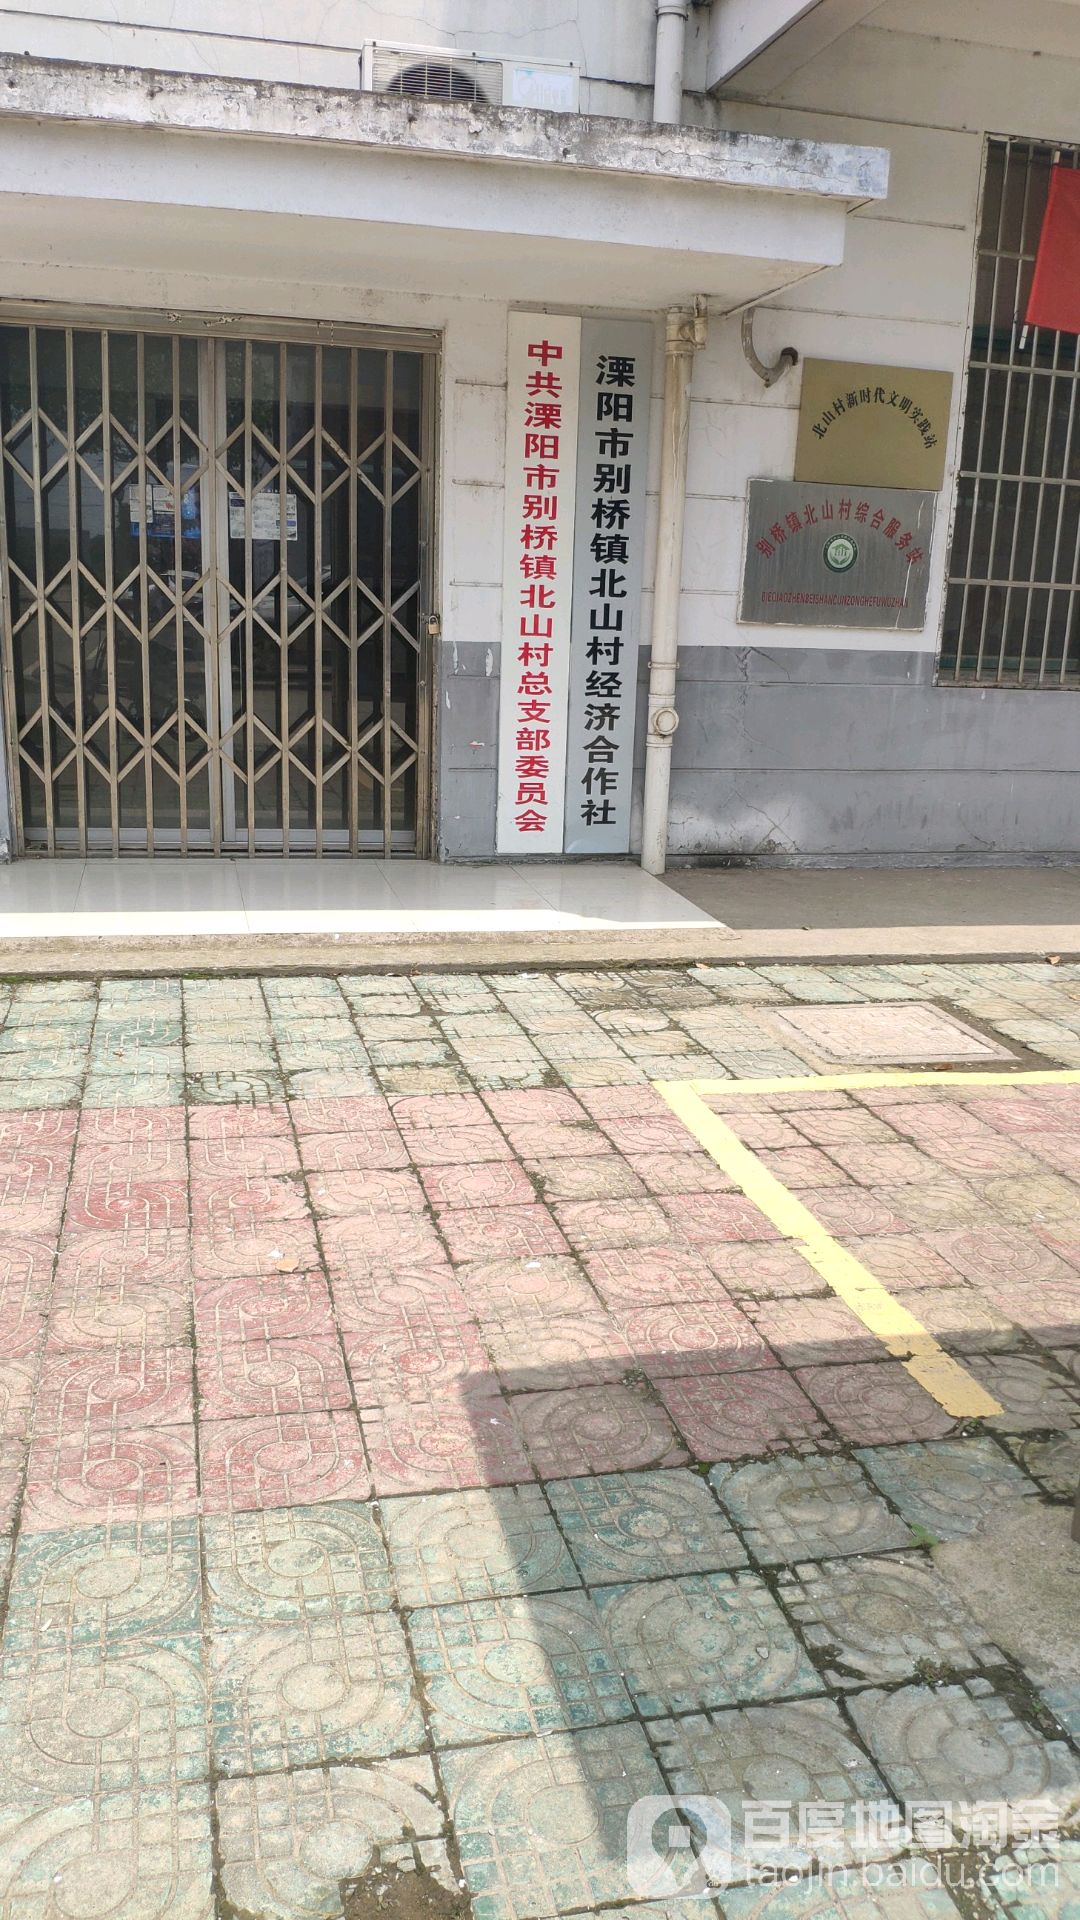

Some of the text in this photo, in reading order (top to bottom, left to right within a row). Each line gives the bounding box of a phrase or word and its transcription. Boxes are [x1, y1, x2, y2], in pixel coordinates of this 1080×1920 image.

[755, 498, 924, 565] 别桥镇北山村综合服务站
[811, 387, 938, 450] 北山村新时代文明实践站
[514, 340, 563, 832] 中共溧阳市别桥镇北山村总支部委员会
[580, 355, 636, 826] 溧阳市别桥镇北山村经济合作社
